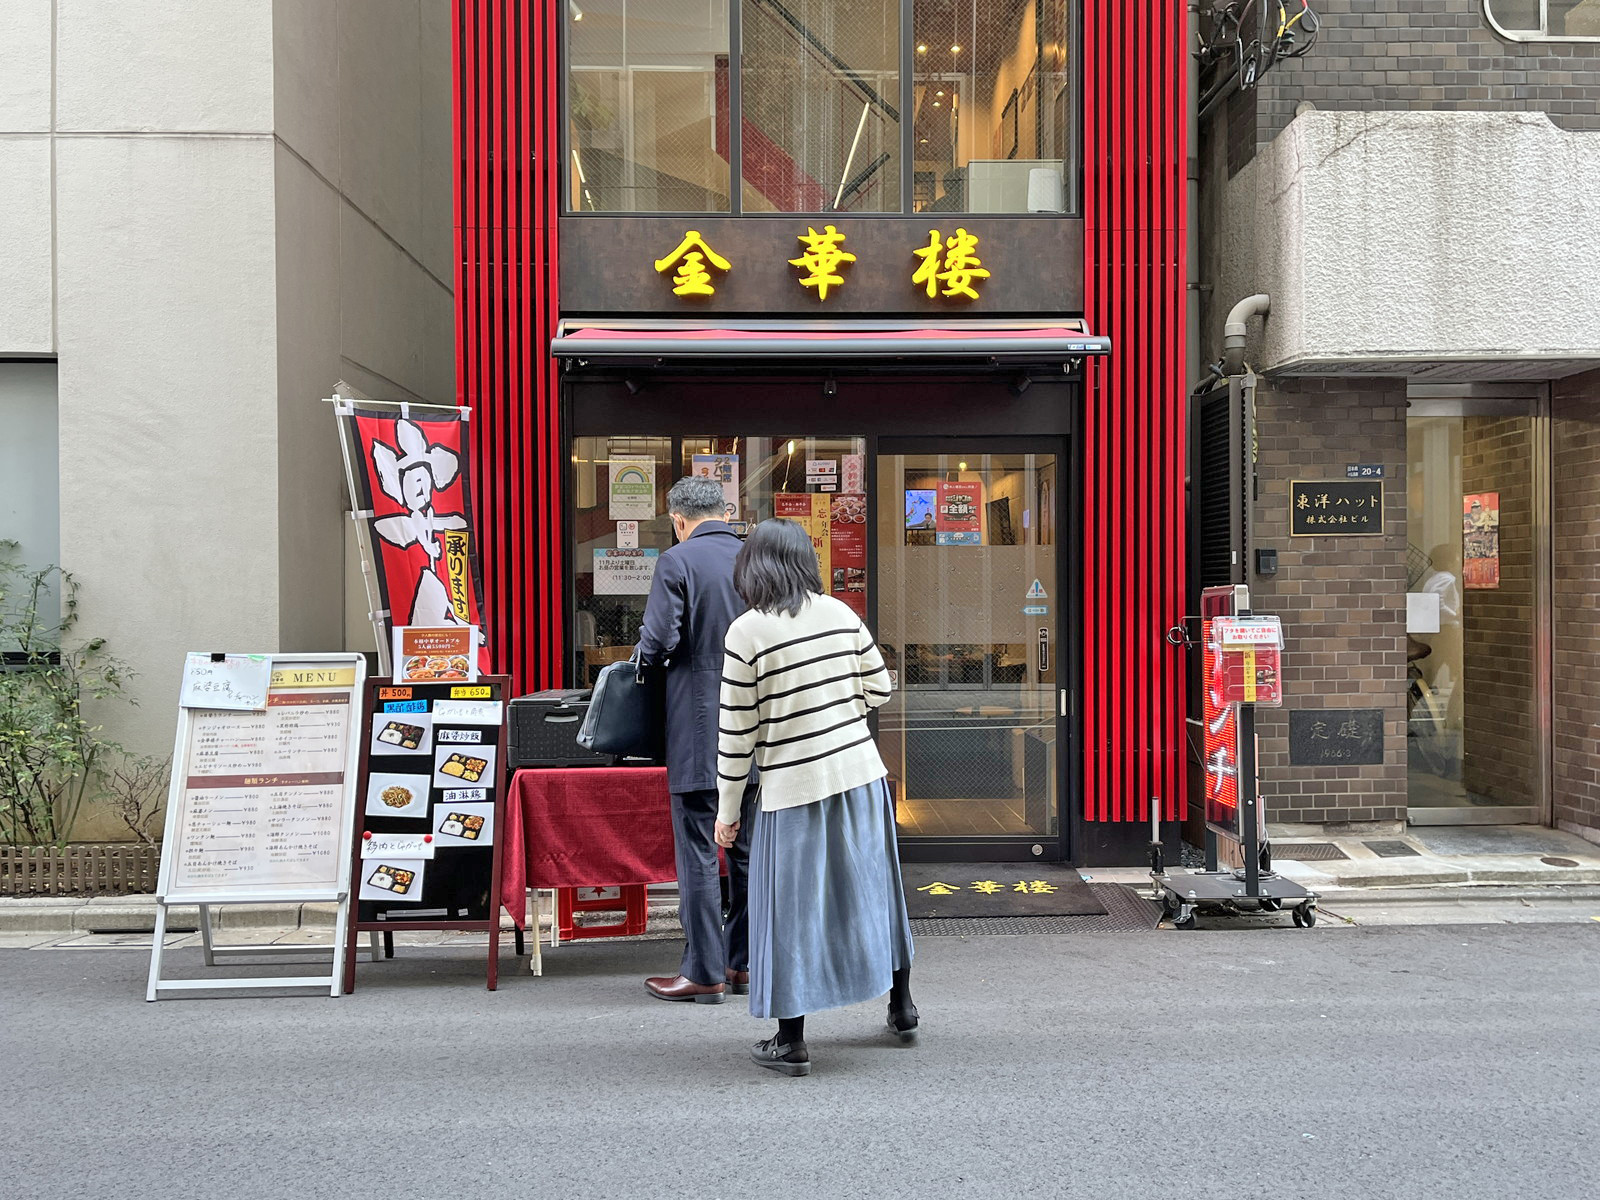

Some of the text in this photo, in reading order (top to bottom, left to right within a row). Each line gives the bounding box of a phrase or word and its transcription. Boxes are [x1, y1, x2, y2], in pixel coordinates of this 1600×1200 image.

[654, 225, 991, 301] 金華楼
[1362, 467, 1381, 475] 20-4
[1297, 493, 1379, 510] 東洋ハット
[1306, 515, 1369, 524] 株式会社ビル
[293, 672, 337, 683] MENU
[917, 880, 1059, 895] 金華楼
